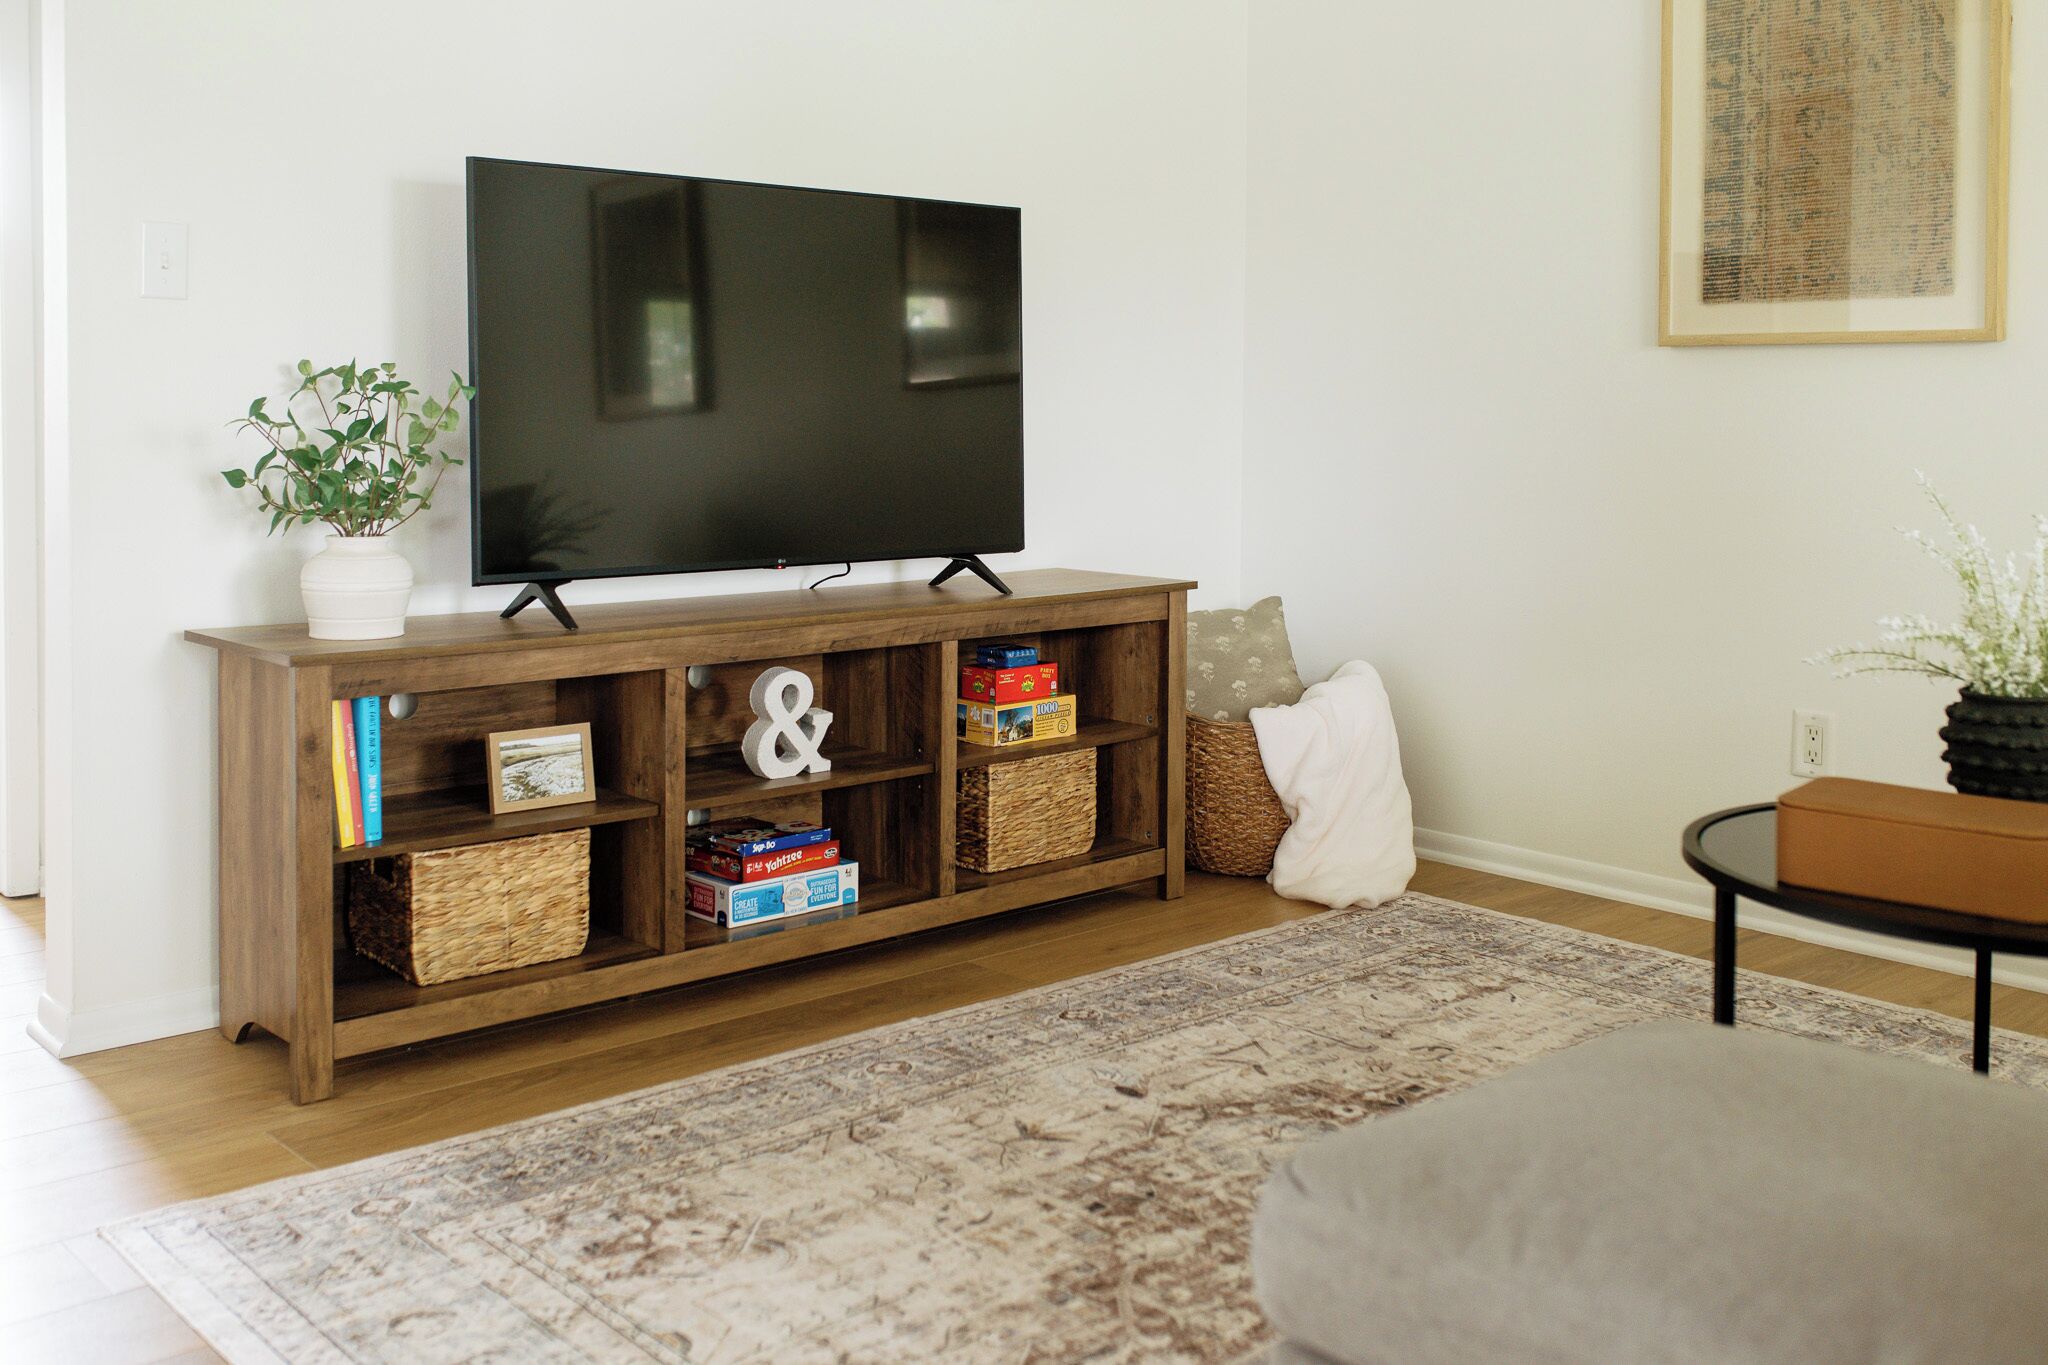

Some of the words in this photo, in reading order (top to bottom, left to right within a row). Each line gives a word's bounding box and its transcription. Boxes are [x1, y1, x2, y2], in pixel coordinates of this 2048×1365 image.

[1036, 701, 1058, 716] 1000
[744, 667, 833, 779] &
[764, 850, 803, 874] Yahtzee
[811, 886, 824, 896] FUN
[824, 883, 836, 892] FOR
[734, 897, 758, 910] CREATE
[811, 893, 836, 903] EVERYONE
